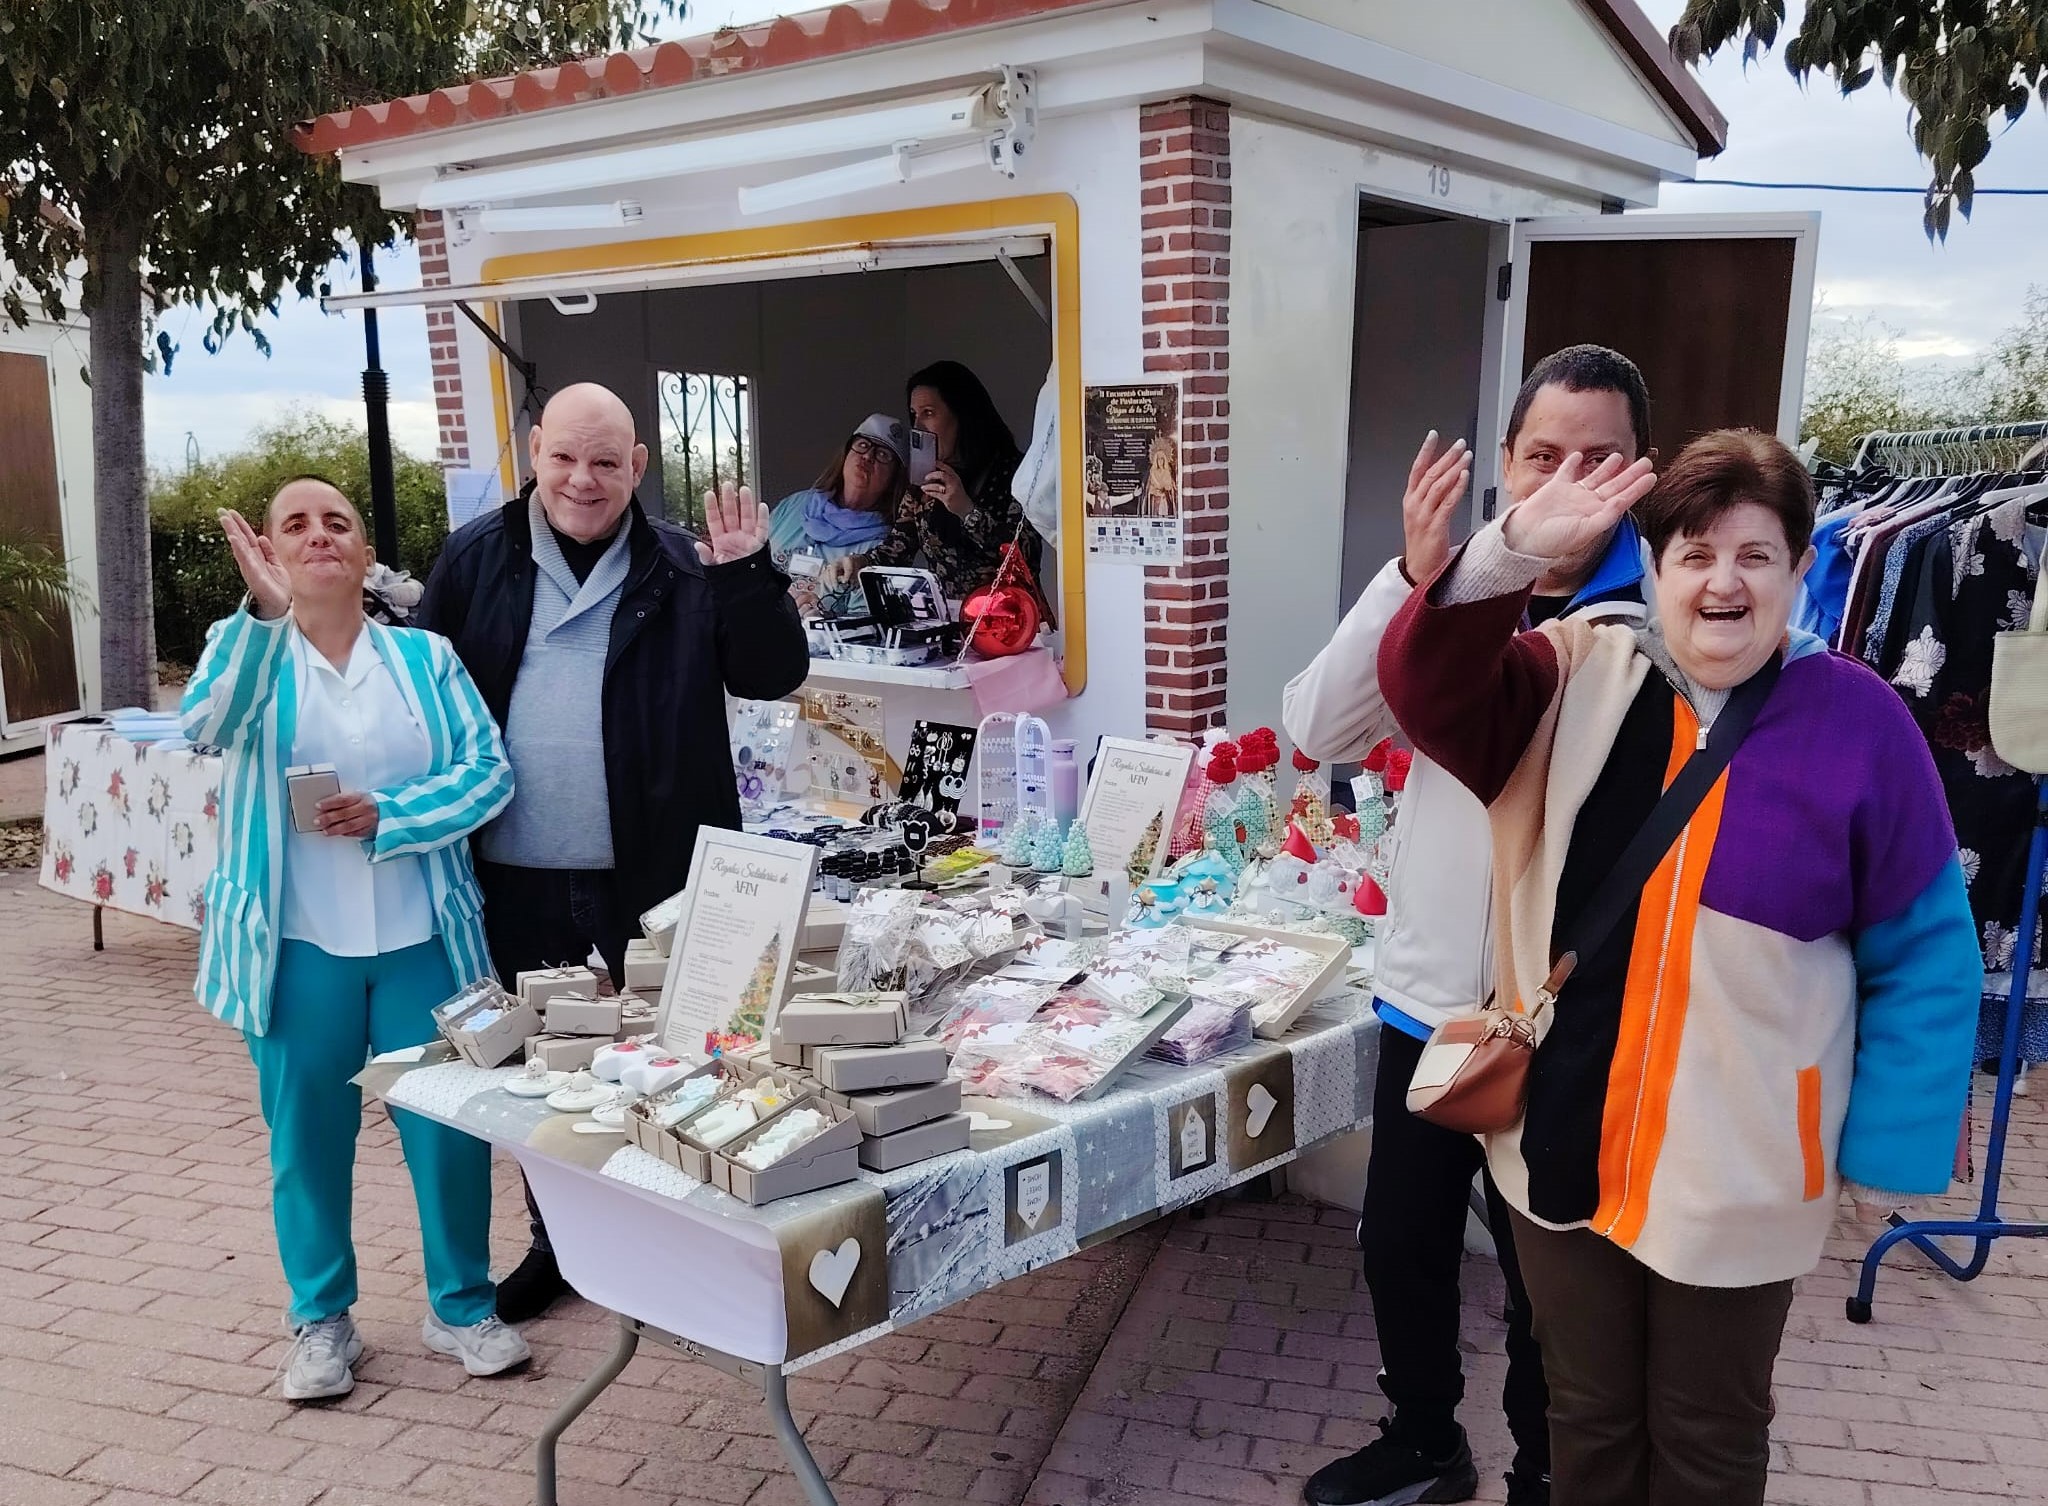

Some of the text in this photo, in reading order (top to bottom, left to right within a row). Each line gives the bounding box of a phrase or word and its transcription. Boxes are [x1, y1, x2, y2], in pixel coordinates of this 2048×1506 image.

[1428, 165, 1450, 197] 19
[1106, 389, 1136, 398] Encuentro
[1137, 388, 1163, 397] Cultural
[1120, 397, 1152, 405] Pastorales
[1128, 405, 1135, 414] de
[1136, 405, 1142, 413] la
[710, 856, 789, 885] Regalos Solidarios de
